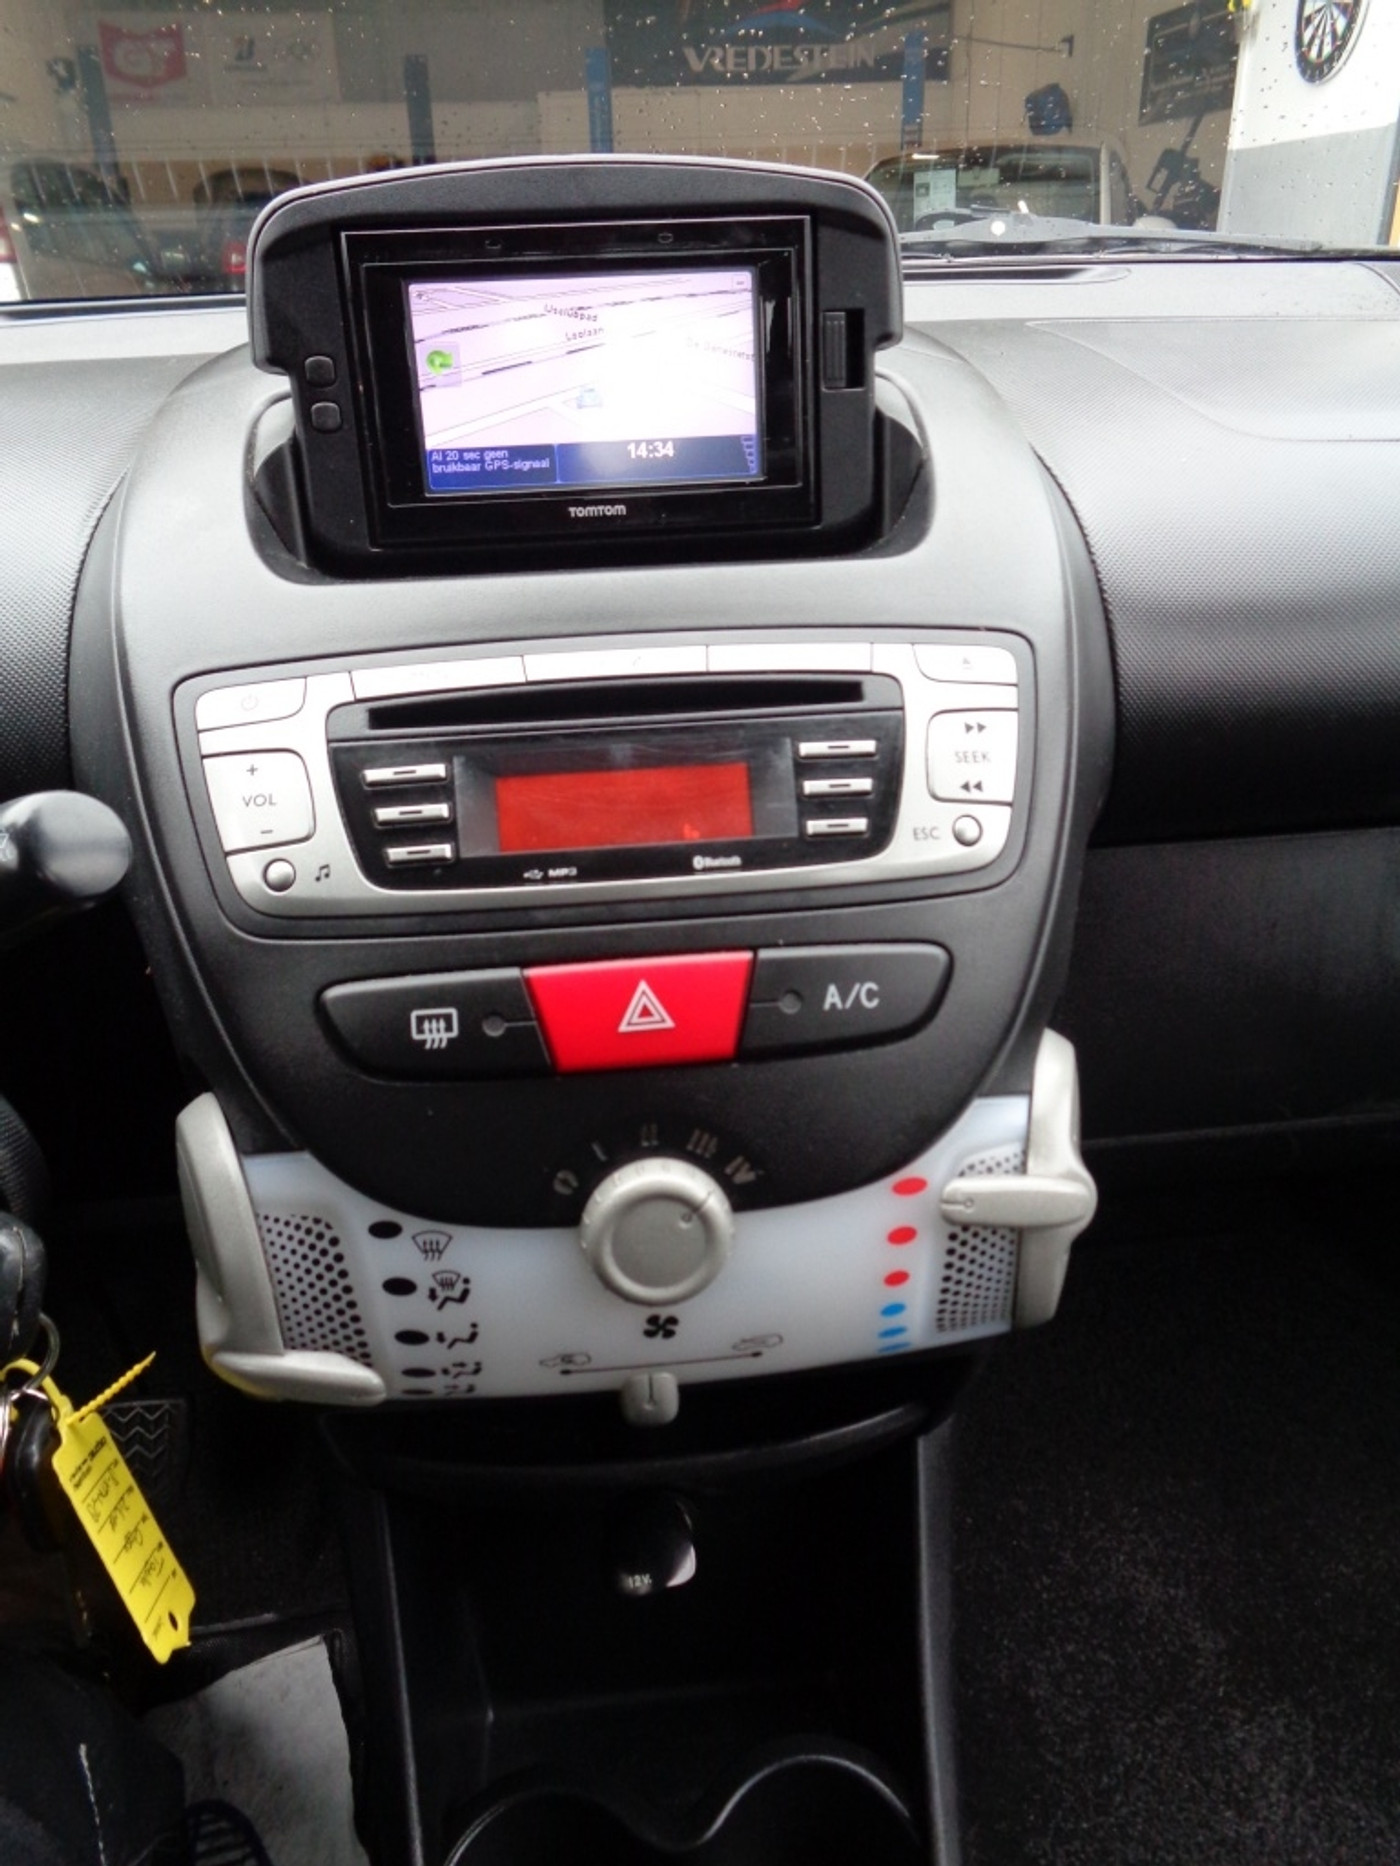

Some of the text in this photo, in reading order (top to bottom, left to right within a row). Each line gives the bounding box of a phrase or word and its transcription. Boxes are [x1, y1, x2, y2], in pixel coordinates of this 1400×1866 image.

[683, 43, 875, 73] VREDESTEIN
[445, 451, 459, 460] 20
[463, 451, 480, 460] sec
[483, 450, 509, 461] geen
[627, 441, 675, 459] 14:34
[432, 458, 550, 473] bruikbaar GPS-signaal
[954, 749, 991, 764] SEEK
[242, 794, 277, 808] VOL
[913, 827, 941, 841] ESC
[547, 866, 578, 878] MP3
[822, 981, 880, 1011] A/C
